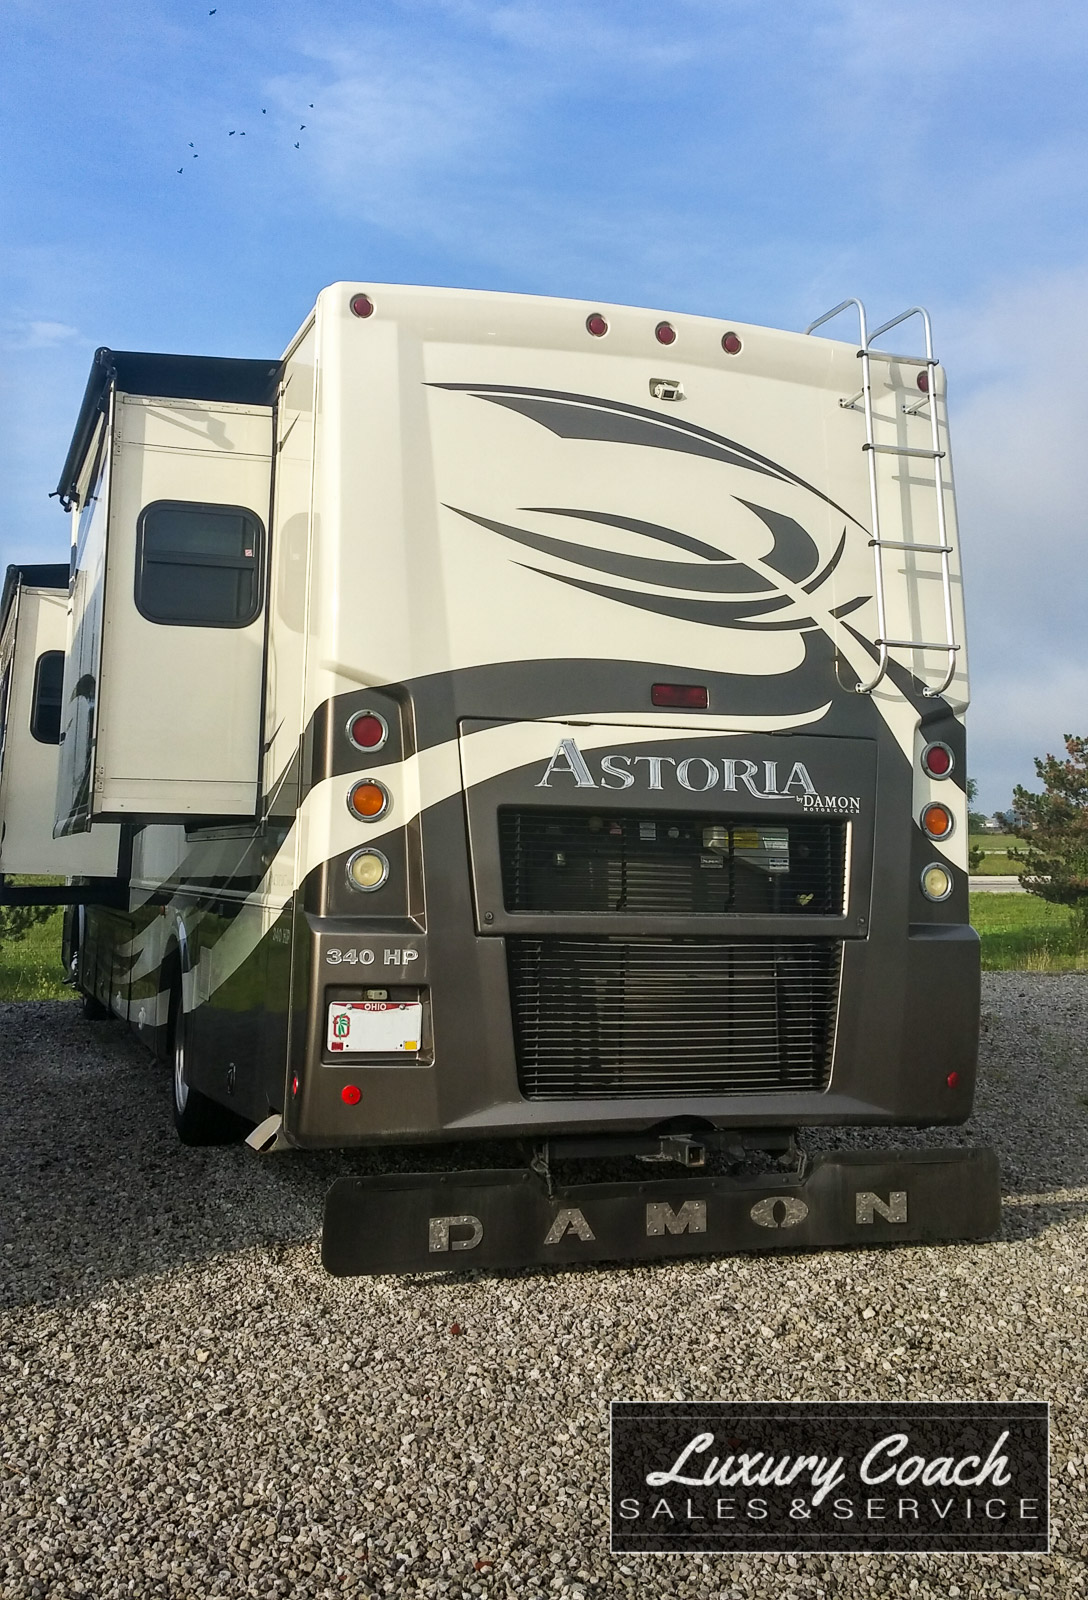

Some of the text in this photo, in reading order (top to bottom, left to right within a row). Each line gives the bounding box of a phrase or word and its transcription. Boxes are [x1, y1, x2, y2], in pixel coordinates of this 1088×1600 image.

[534, 738, 819, 799] ASTORIA
[803, 795, 860, 809] DAMON
[326, 949, 419, 965] 340 HP
[364, 1003, 387, 1011] OHIO
[428, 1191, 908, 1253] DAMON
